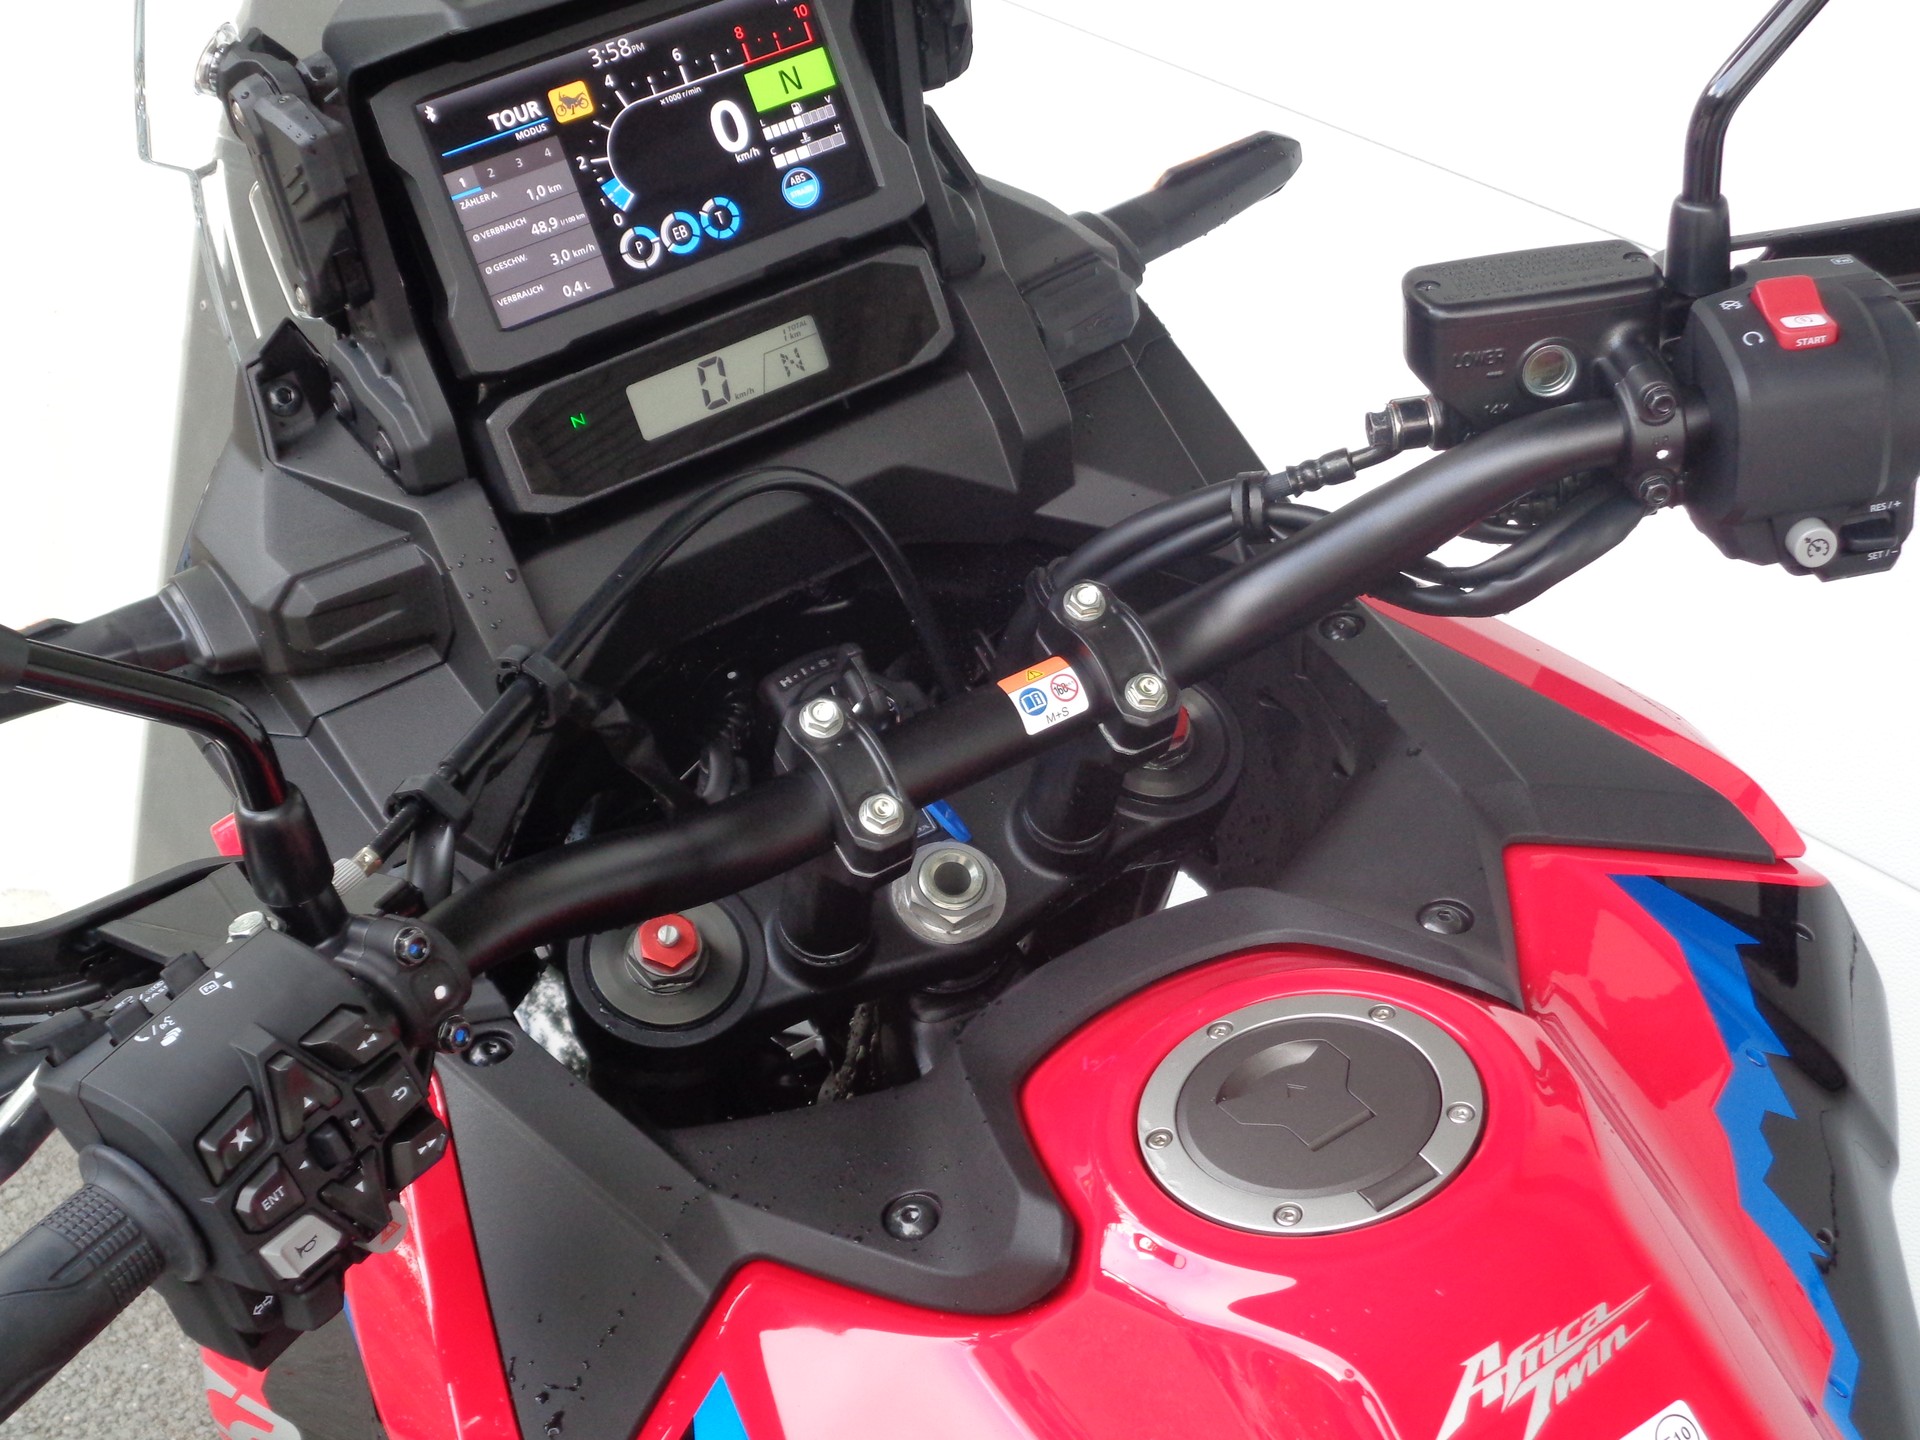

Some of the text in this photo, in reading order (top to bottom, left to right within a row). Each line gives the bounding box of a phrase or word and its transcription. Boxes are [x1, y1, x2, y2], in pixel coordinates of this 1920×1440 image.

[793, 4, 808, 18] 10
[734, 26, 744, 39] 8
[588, 38, 645, 67] 3:58 PM
[672, 48, 682, 61] 6
[604, 74, 614, 87] 4
[778, 65, 803, 94] N
[682, 86, 702, 98] r/min
[824, 95, 831, 103] V
[488, 101, 542, 131] TOUR
[760, 119, 766, 127] L
[515, 123, 547, 141] MODUS
[710, 100, 749, 153] 0
[834, 124, 842, 132] H
[735, 147, 760, 163] km/h
[770, 147, 777, 155] C
[458, 147, 551, 187] 1 2 3 4
[576, 156, 586, 170] 2
[790, 172, 806, 186] ABS
[526, 183, 563, 201] 1,0 km
[460, 191, 498, 210] ZÄHLER A
[531, 217, 558, 235] 48,9
[575, 213, 586, 222] km
[613, 214, 623, 226] 0
[714, 211, 724, 225] T
[480, 217, 527, 239] VERBRAUCH
[672, 225, 688, 240] EB
[550, 243, 595, 266] 3,0 km/h
[635, 241, 643, 255] P
[493, 254, 528, 272] GESCHW.
[497, 284, 544, 307] VERBRAUCH
[562, 281, 591, 297] 0,4 L
[788, 320, 808, 332] TOTAL
[790, 331, 801, 340] km
[1796, 335, 1827, 347] START
[779, 347, 805, 377] N
[1453, 348, 1504, 367] LOWER
[697, 356, 730, 410] 0
[734, 387, 755, 401] km/h
[570, 413, 587, 428] N
[1046, 706, 1070, 724] M+S
[261, 1185, 284, 1211] ENT
[1436, 1284, 1650, 1440] Africa
[1506, 1300, 1650, 1440] Twin
[1664, 1426, 1692, 1440] 10
